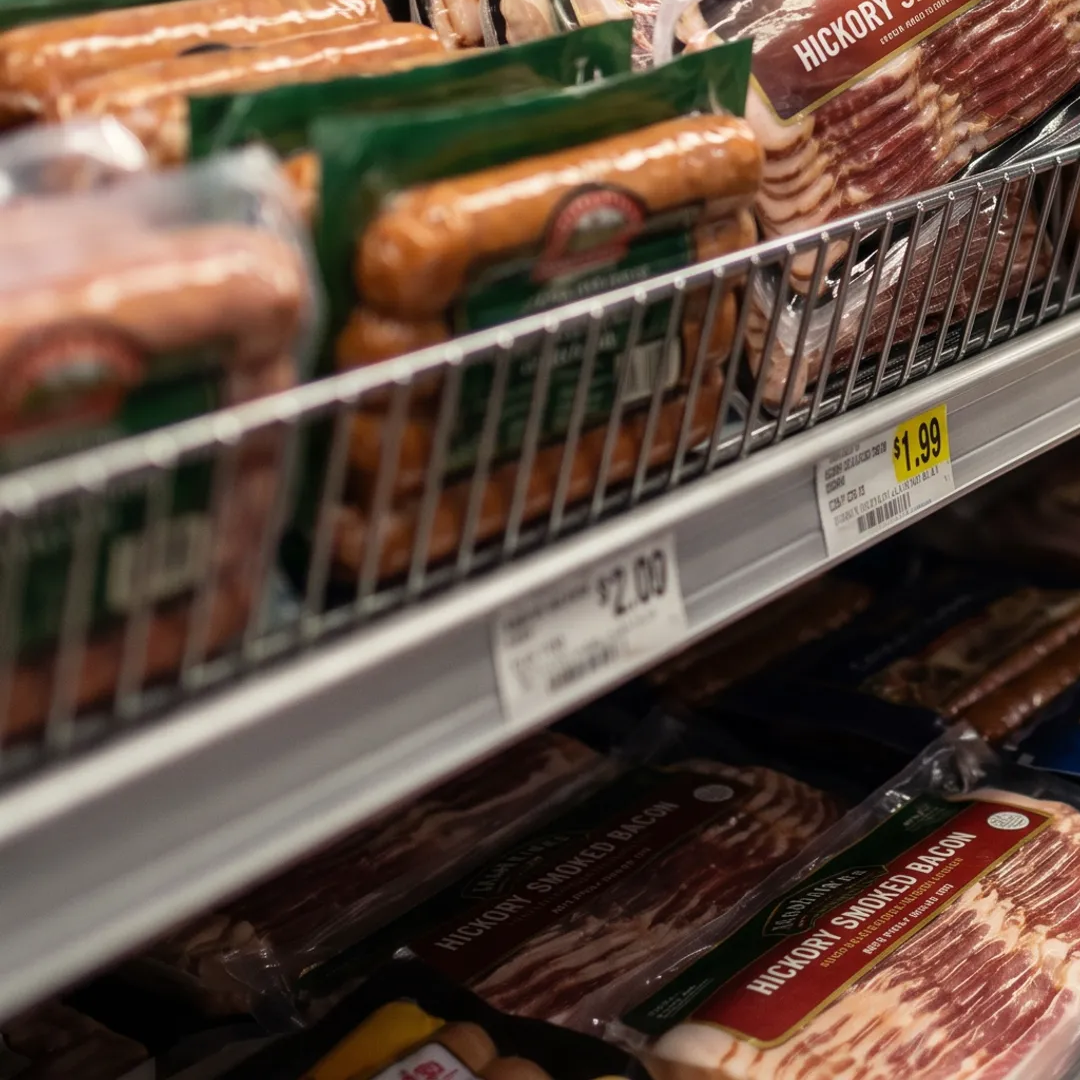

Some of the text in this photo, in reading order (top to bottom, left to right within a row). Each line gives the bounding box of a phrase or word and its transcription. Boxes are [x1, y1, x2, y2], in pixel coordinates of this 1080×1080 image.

[893, 417, 941, 471] $1.99
[435, 894, 532, 951] HICKORY
[527, 842, 616, 894] SMOKED
[608, 800, 680, 841] BACON
[747, 928, 841, 995] HICKORY
[831, 874, 916, 929] SMOKED
[905, 831, 977, 874] BACON
